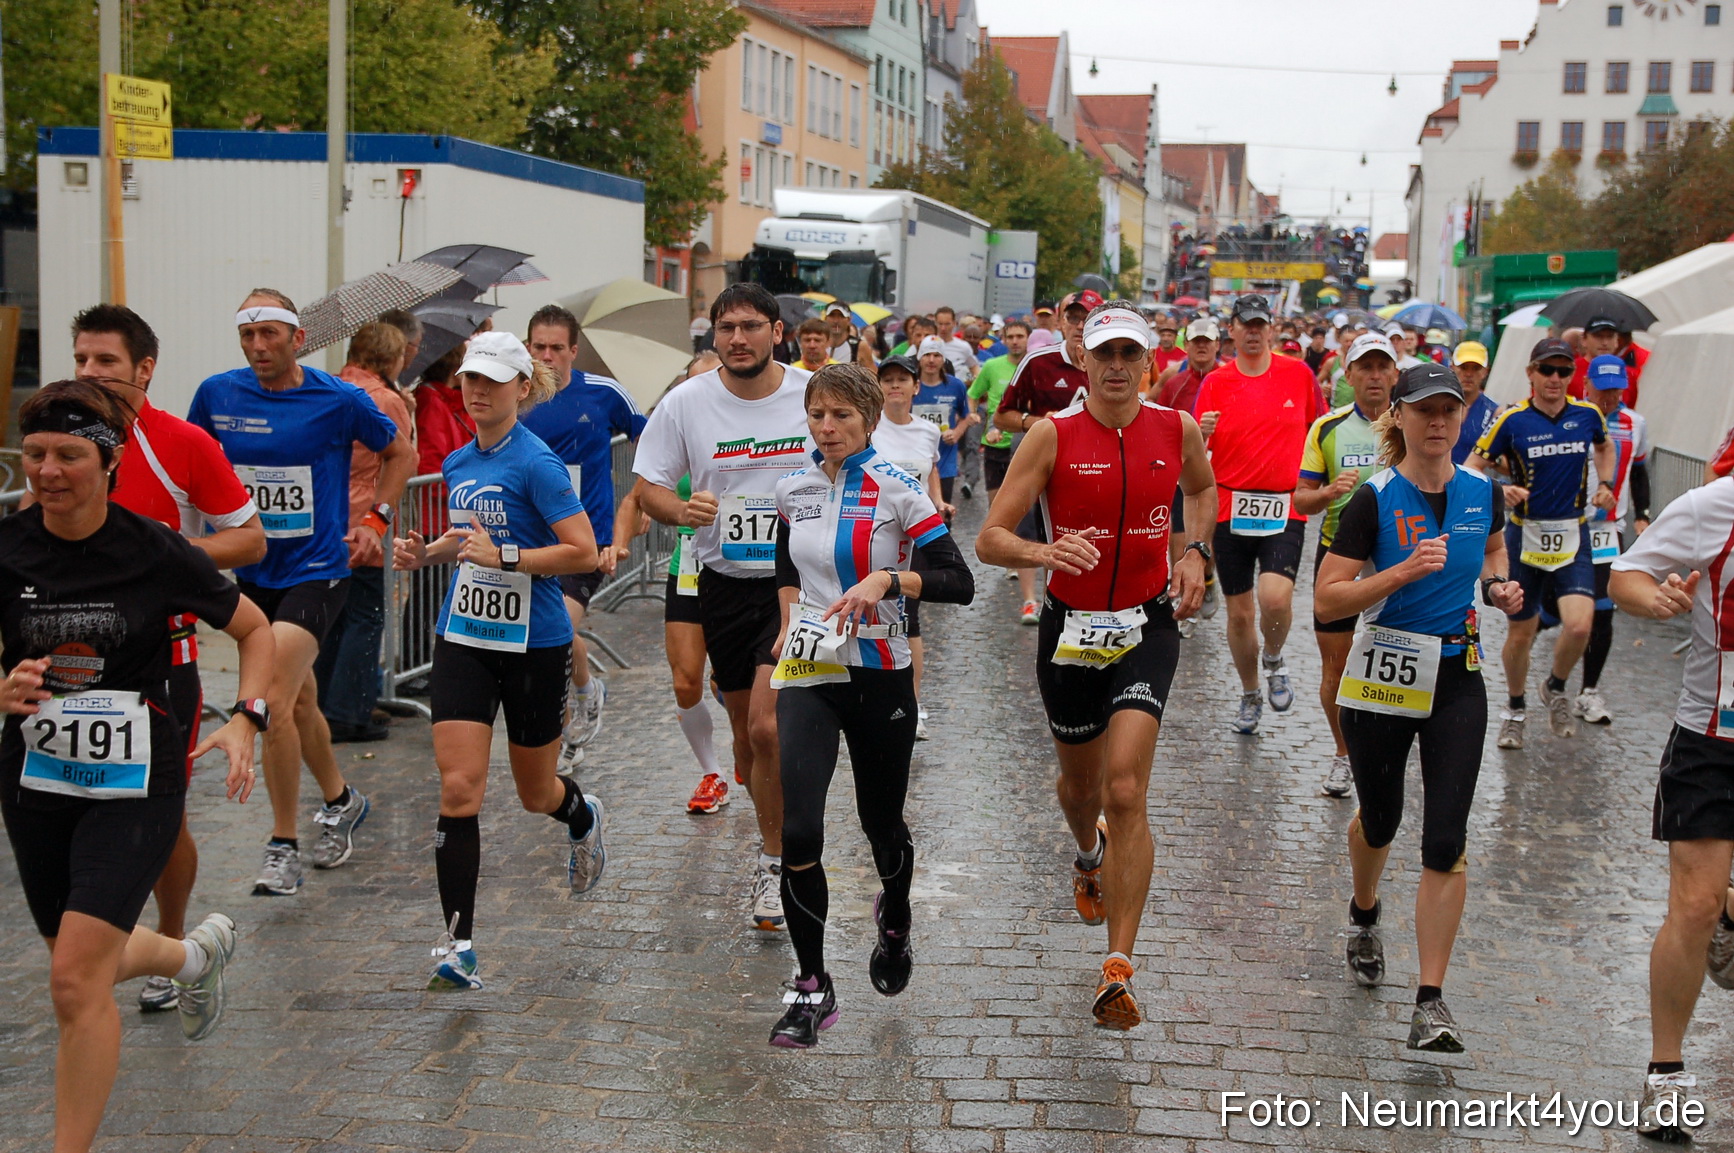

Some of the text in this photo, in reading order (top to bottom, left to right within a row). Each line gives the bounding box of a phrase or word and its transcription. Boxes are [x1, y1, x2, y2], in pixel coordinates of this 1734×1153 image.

[785, 229, 847, 245] BOCK
[1246, 265, 1286, 275] START
[1526, 434, 1553, 443] TEAM
[1528, 441, 1586, 459] BOCK
[255, 470, 287, 479] BOCK
[473, 496, 503, 512] FÜRTH
[1237, 497, 1284, 519] 2570
[1540, 533, 1563, 552] 99
[745, 547, 776, 559] Alber
[472, 570, 502, 582] BOCK
[458, 583, 521, 622] 3080
[464, 620, 506, 639] Melanie
[1374, 631, 1412, 646] BOCK
[784, 663, 816, 677] Petra
[1362, 647, 1419, 687] 155
[1361, 685, 1405, 704] Sabine
[62, 696, 114, 710] BOCK
[34, 717, 133, 761] 2191
[62, 764, 107, 787] Birgit
